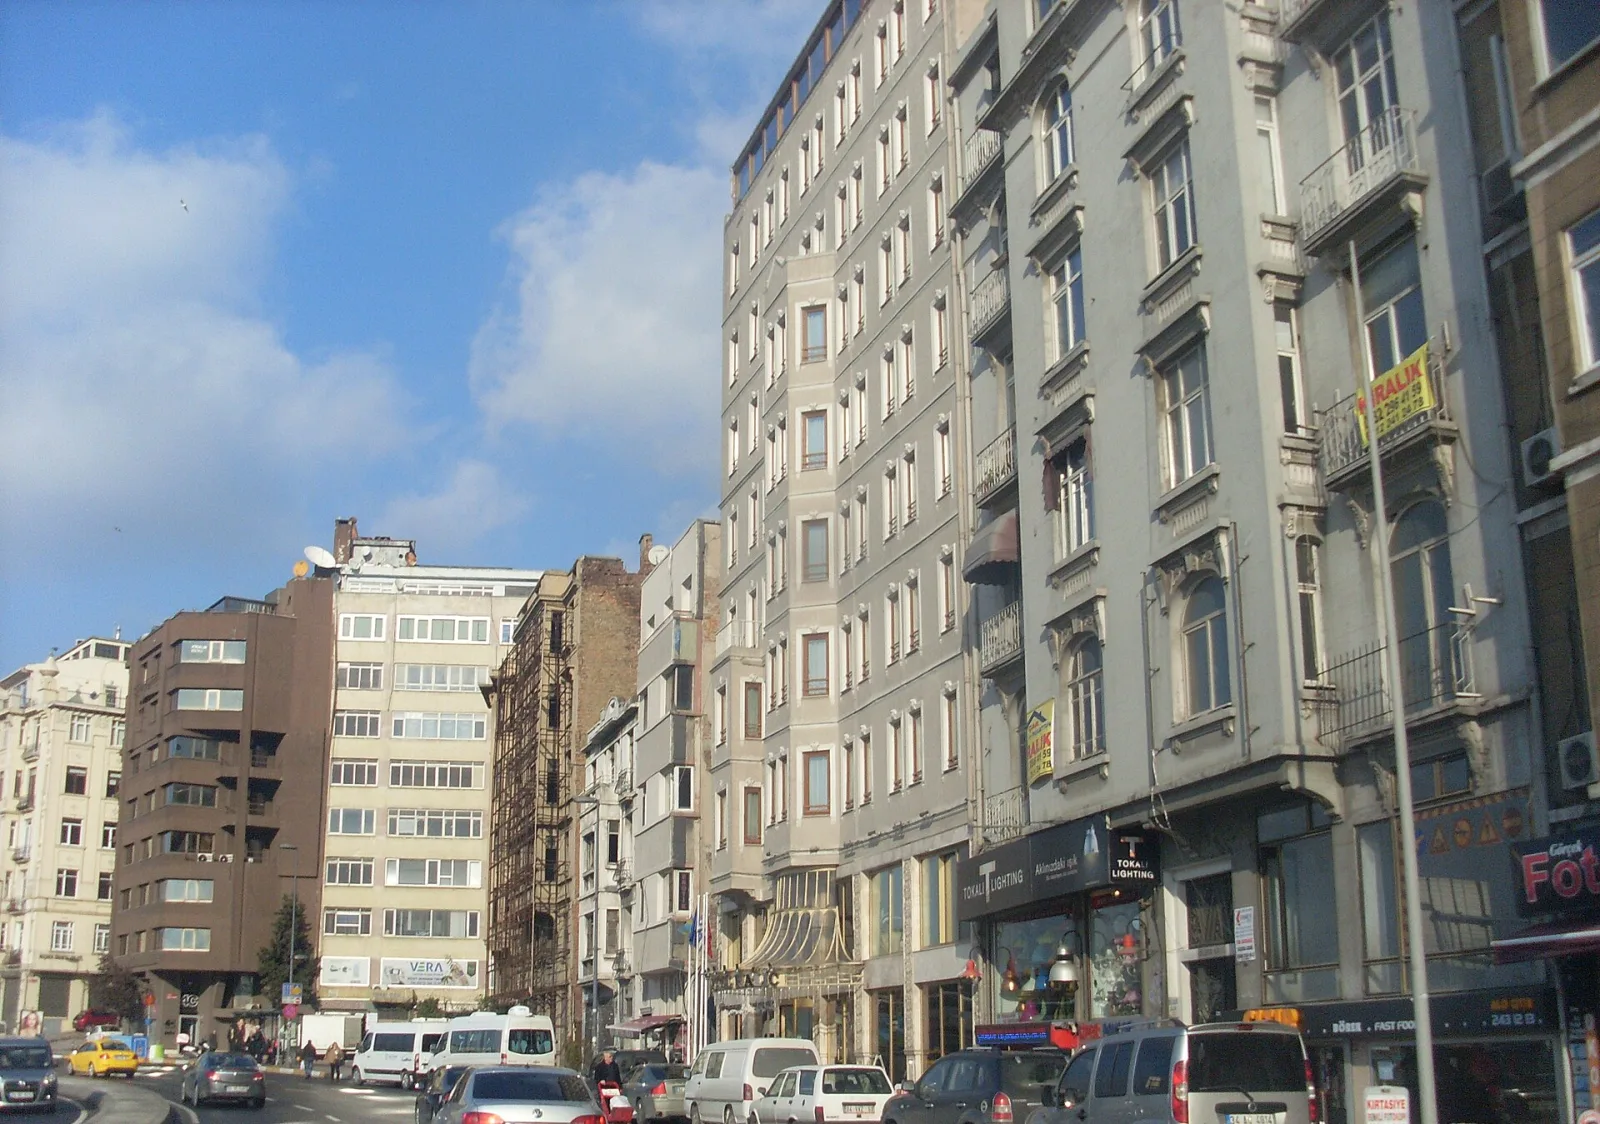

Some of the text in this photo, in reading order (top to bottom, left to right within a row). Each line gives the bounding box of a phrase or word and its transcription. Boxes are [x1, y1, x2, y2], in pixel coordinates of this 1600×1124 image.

[1117, 859, 1149, 868] TOKALI
[1112, 869, 1154, 879] LIGHTING
[963, 881, 985, 900] TOKALI
[990, 868, 1024, 892] LIGHTING
[410, 961, 443, 972] VERA
[1374, 1021, 1396, 1032] FAST
[1396, 1020, 1417, 1031] FOO
